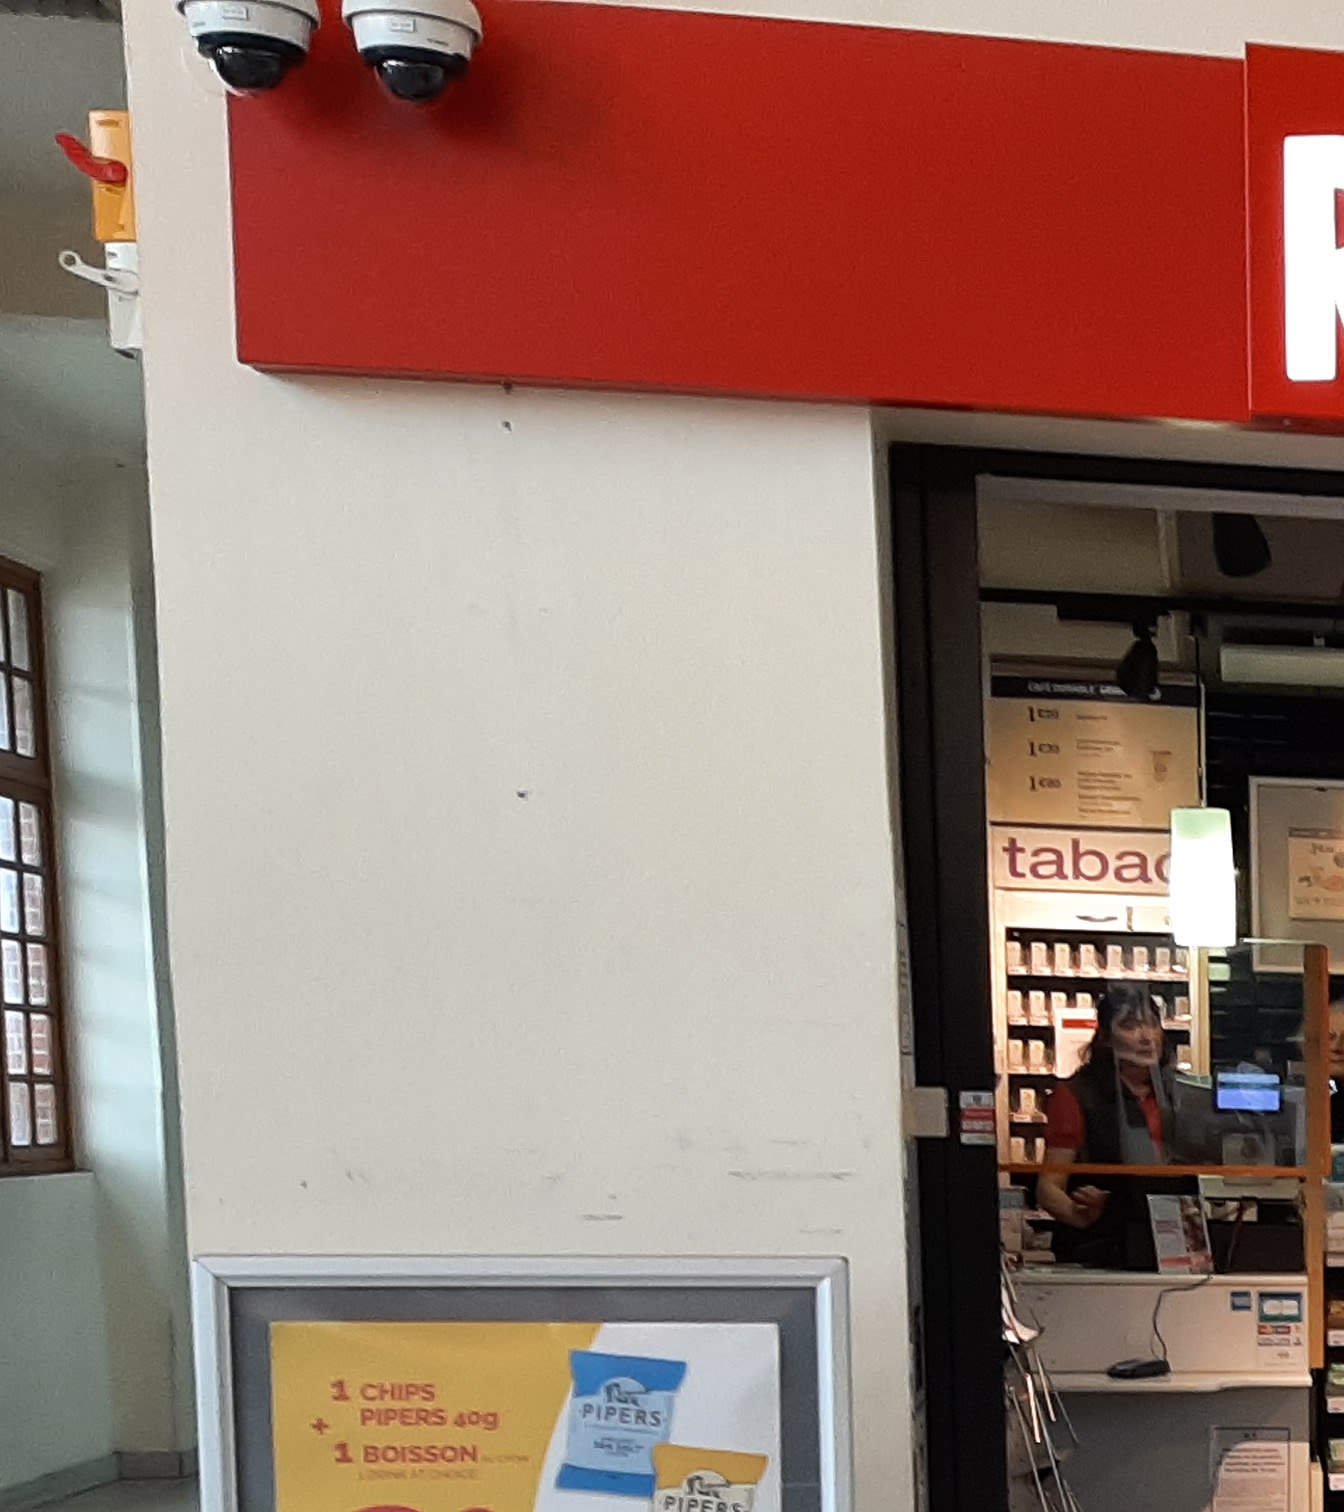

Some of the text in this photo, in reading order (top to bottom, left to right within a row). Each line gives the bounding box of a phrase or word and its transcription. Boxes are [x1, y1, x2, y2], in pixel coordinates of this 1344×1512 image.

[331, 1379, 436, 1401] 1 CHIPS
[360, 1407, 499, 1431] PIPERS 40g
[581, 1403, 662, 1427] PIPERS
[334, 1442, 354, 1463] 1
[363, 1445, 478, 1463] BOISSON
